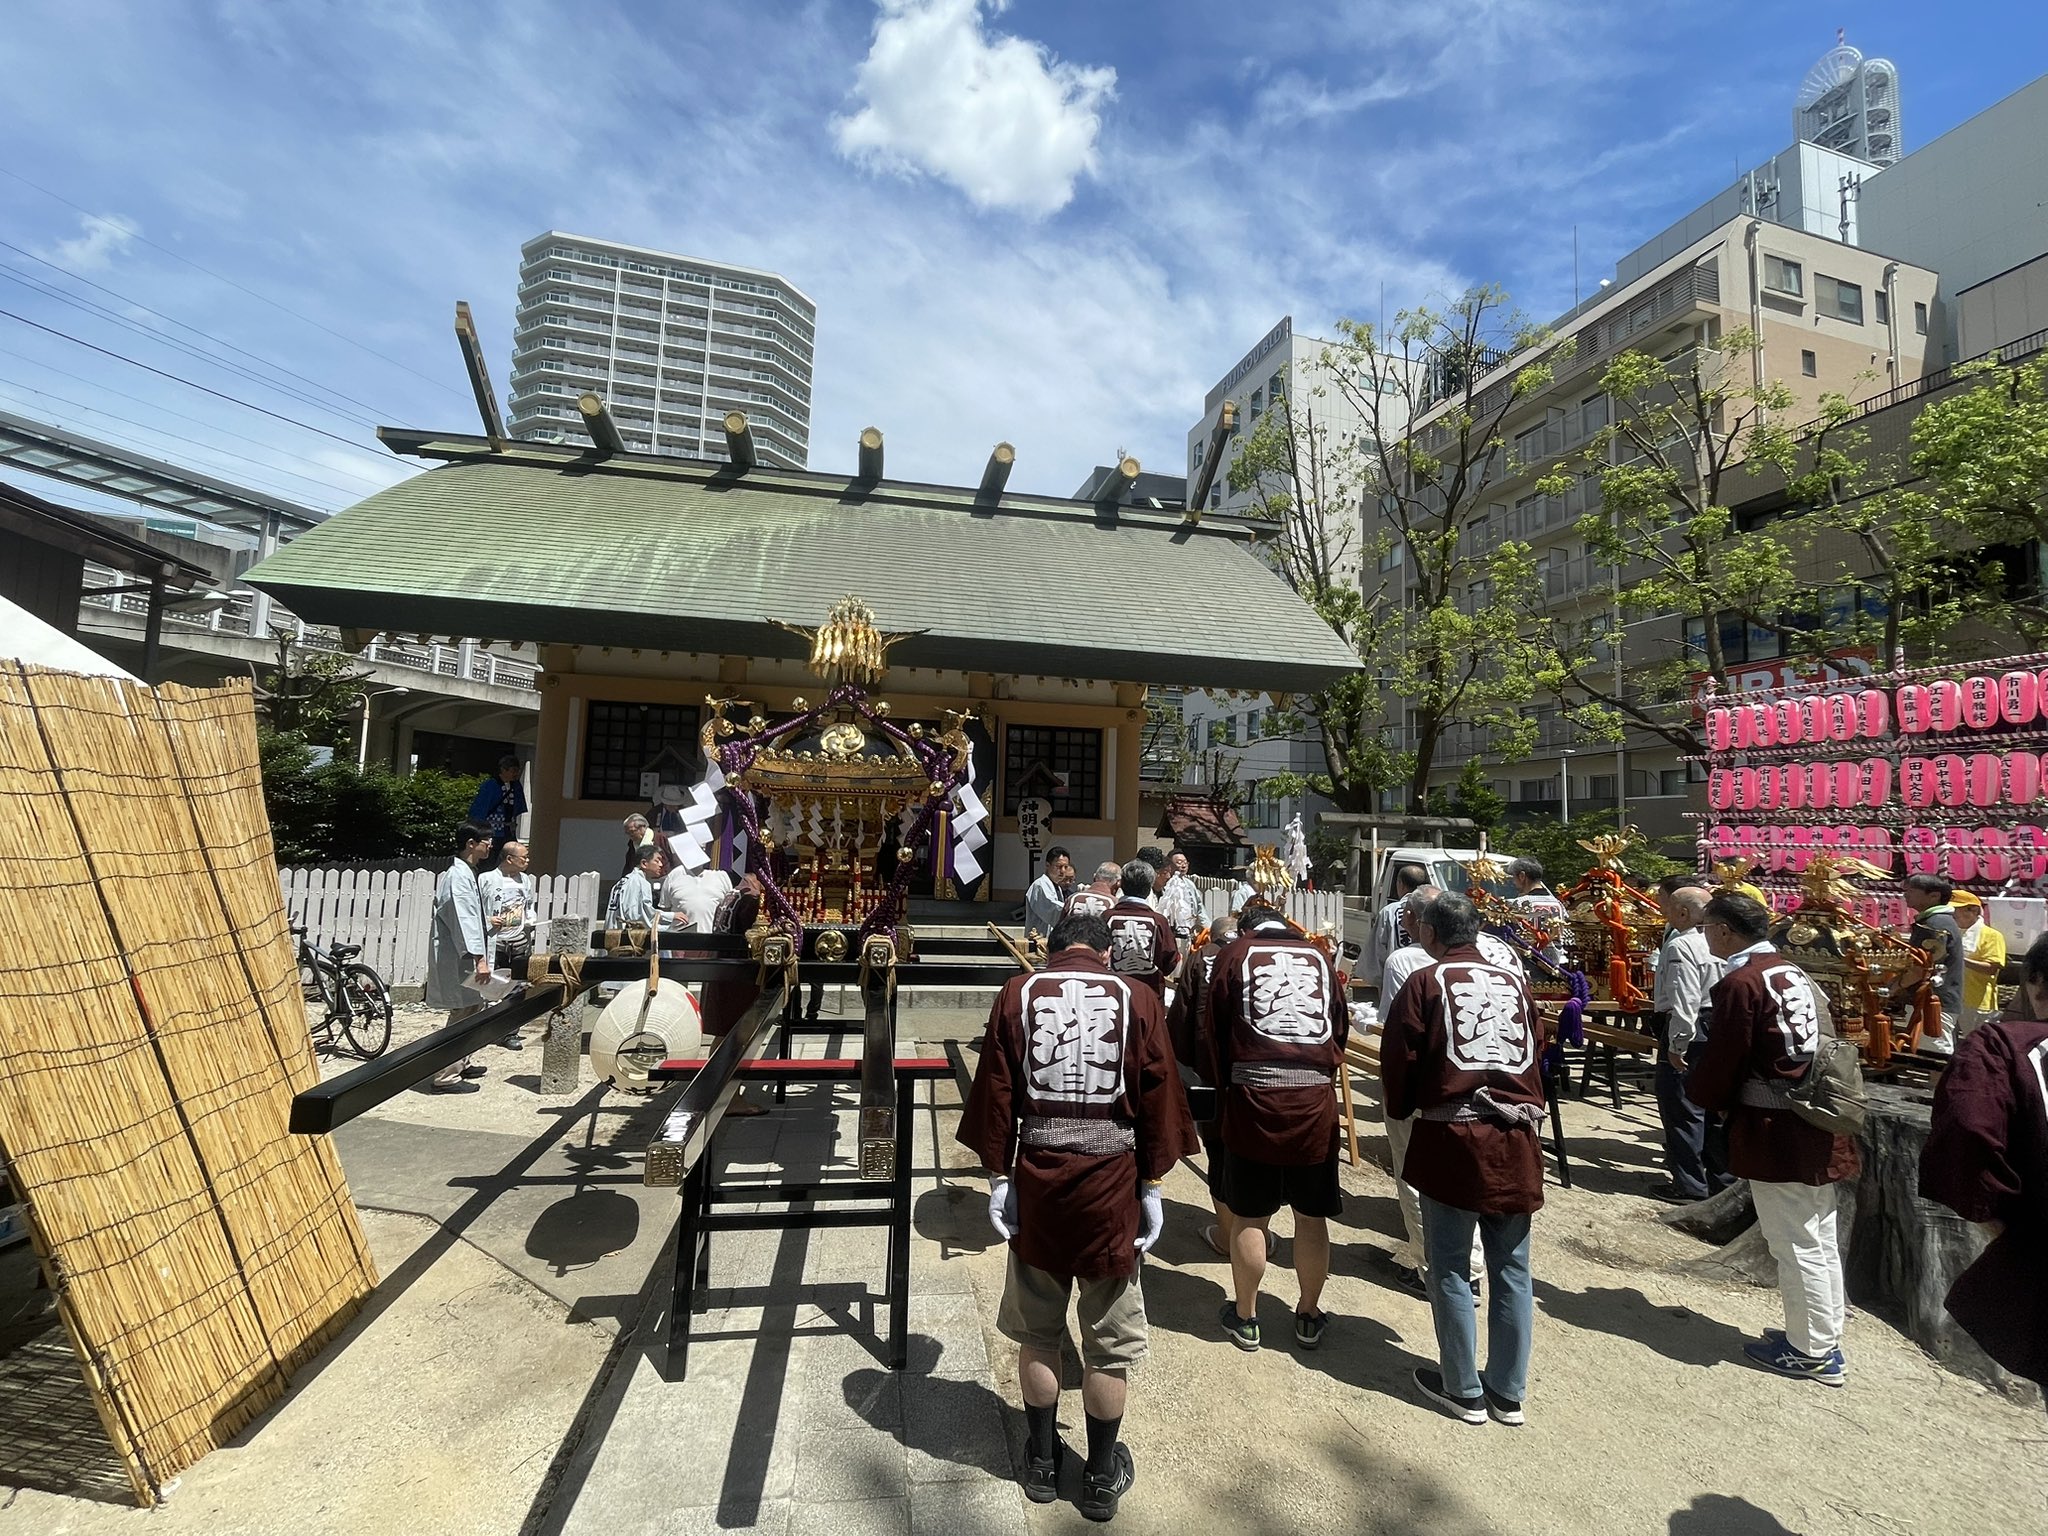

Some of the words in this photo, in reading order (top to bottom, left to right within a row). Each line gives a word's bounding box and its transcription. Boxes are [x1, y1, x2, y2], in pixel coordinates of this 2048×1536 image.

[1222, 349, 1260, 394] FUJIKOU
[1021, 800, 1041, 849] 神明神社
